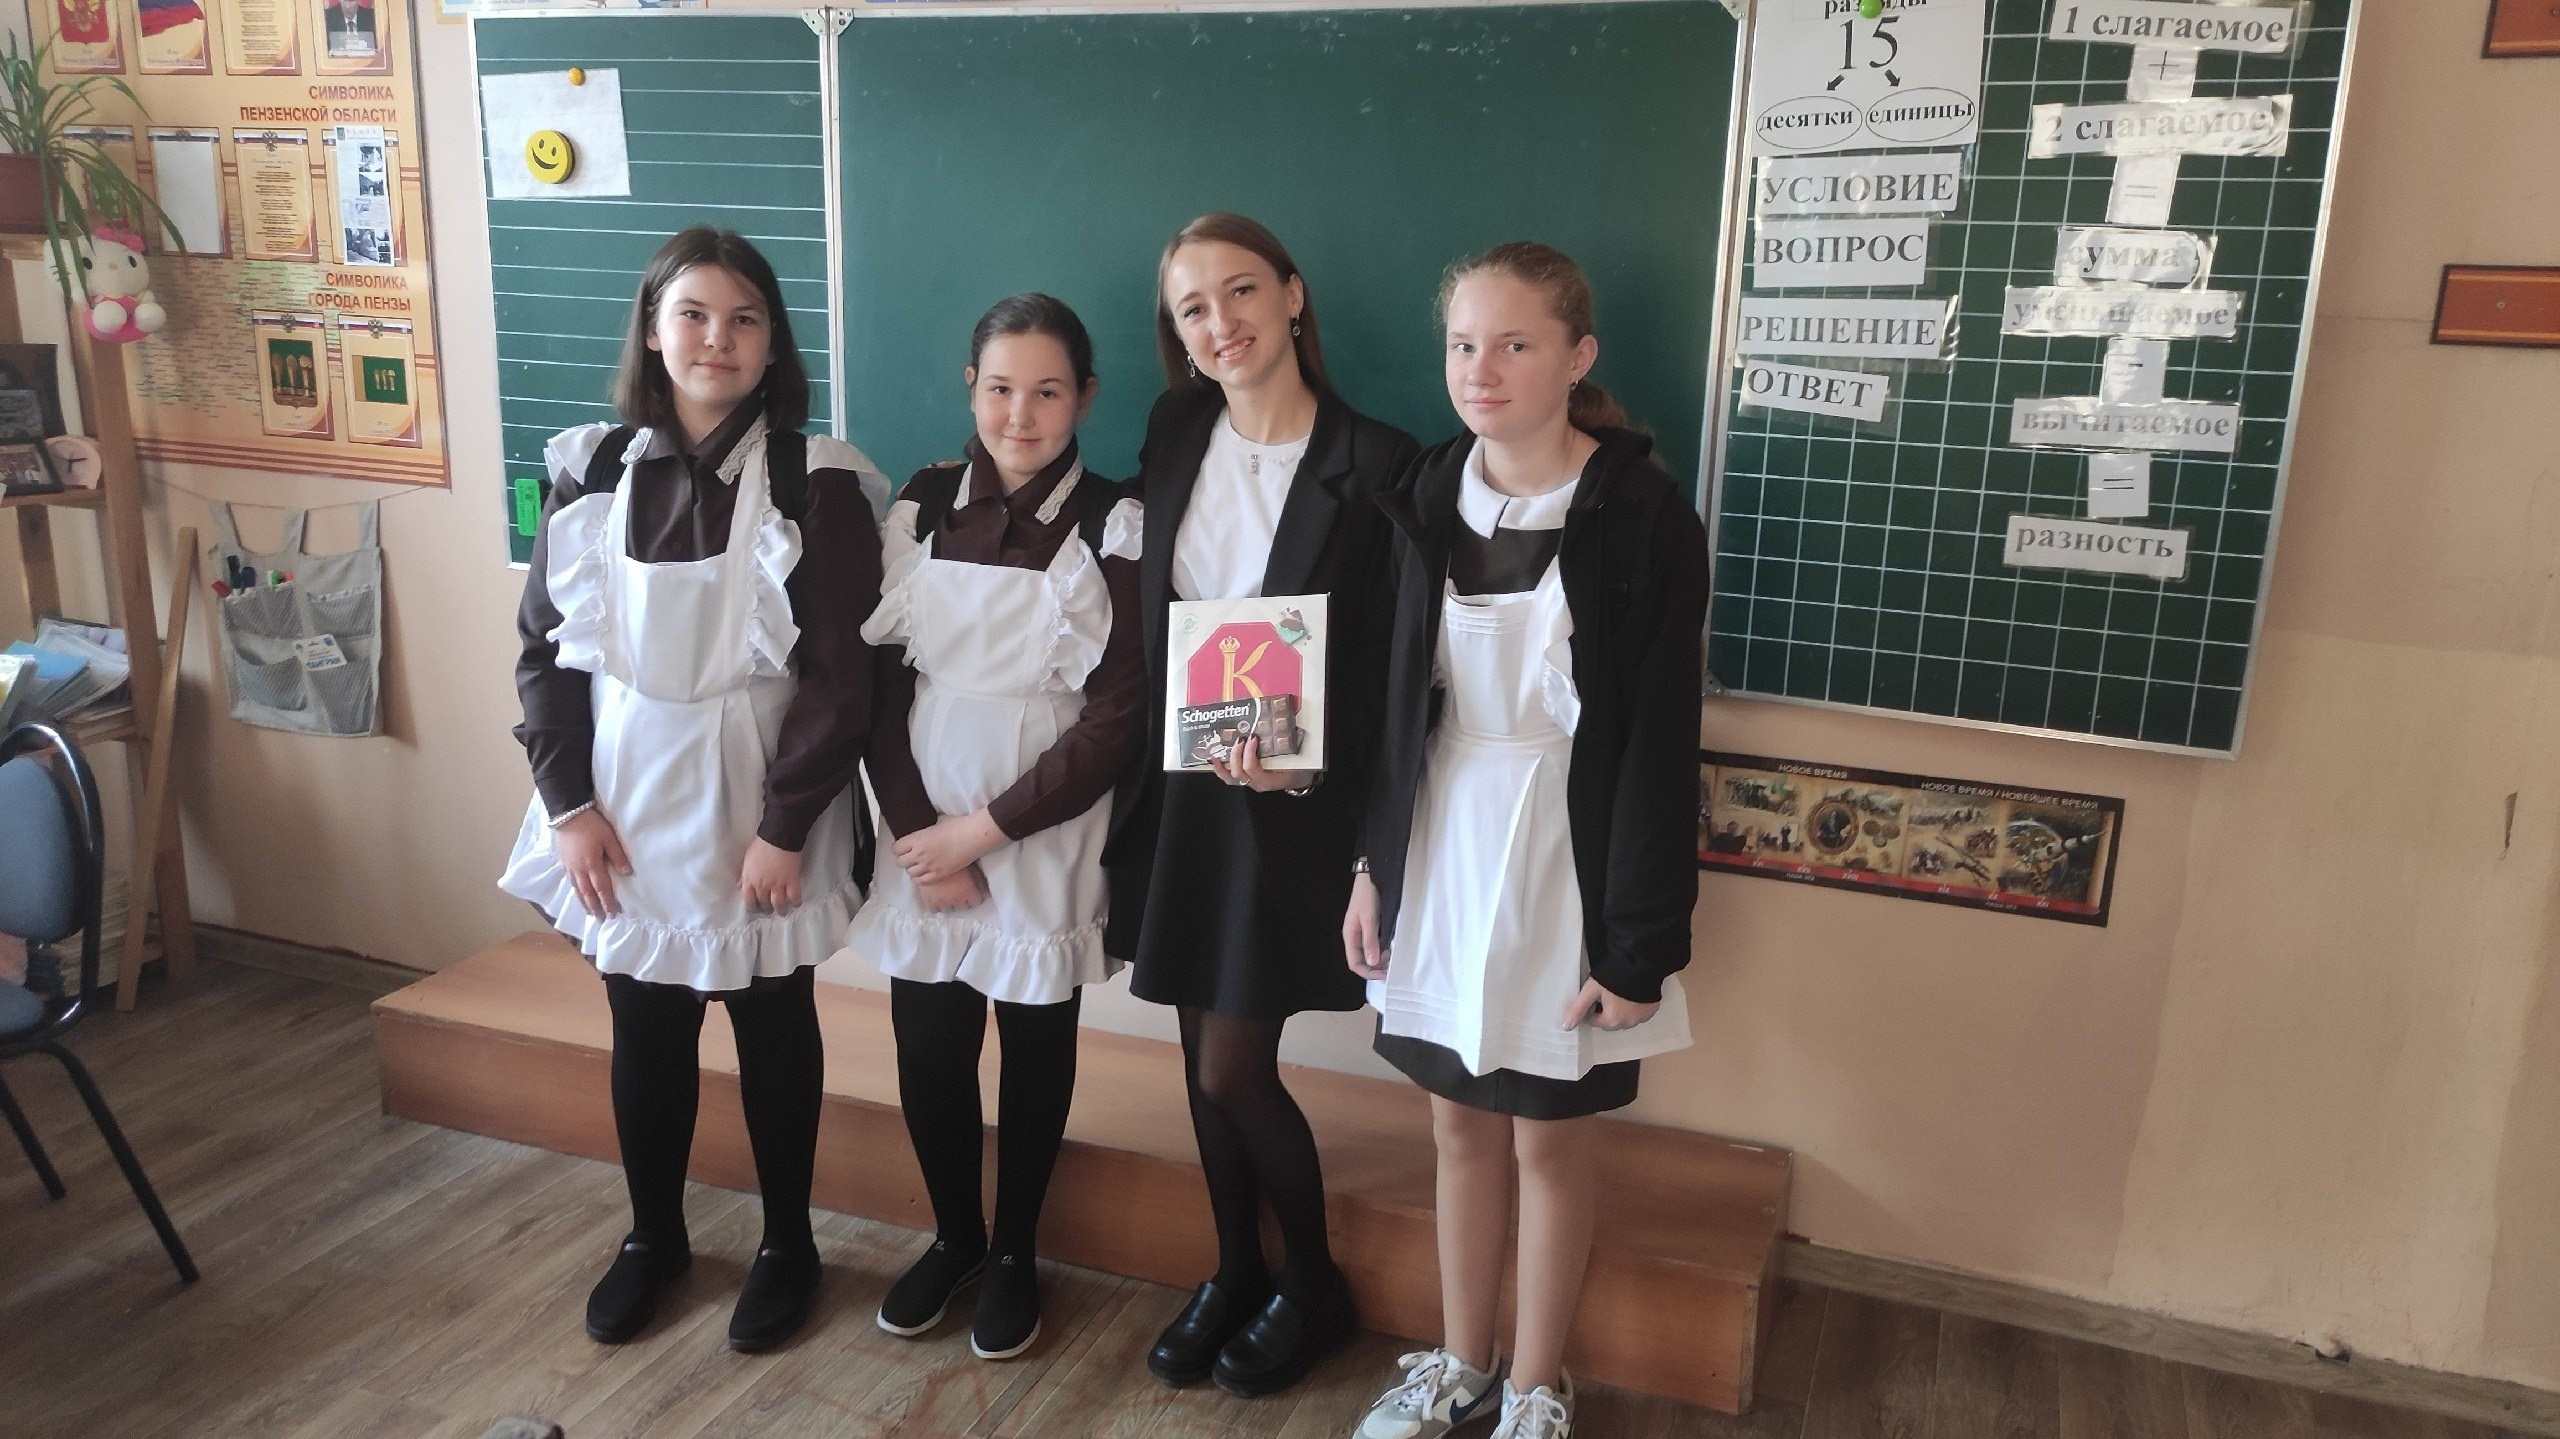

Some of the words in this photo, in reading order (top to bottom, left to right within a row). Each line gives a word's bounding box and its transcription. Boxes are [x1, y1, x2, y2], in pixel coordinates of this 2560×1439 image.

[2064, 7, 2078, 34] 1
[2092, 13, 2283, 43] слагаемое
[1840, 16, 1900, 70] 15
[309, 86, 394, 100] СИМВОЛИКА
[240, 105, 329, 122] ПЕНЗЕНСКОЙ
[333, 108, 397, 123] ОБЛАСТИ
[1758, 110, 1853, 132] десятки
[1869, 103, 1972, 124] единицы
[2045, 116, 2063, 142] 2
[2075, 109, 2271, 140] слагаемое
[1763, 173, 1953, 203] УСЛОВИЕ
[1761, 234, 1924, 264] ВОПРОС
[2067, 245, 2180, 273] сумма
[326, 273, 408, 290] СИМВОЛИКА
[308, 293, 362, 310] ГОРОДА
[364, 296, 411, 311] ПЕНЗЫ
[1743, 316, 1937, 346] РЕШЕНИЕ
[1748, 367, 1873, 408] ОТВЕТ
[2021, 412, 2230, 437] вычитаемое
[2015, 527, 2173, 558] разность
[1181, 704, 1250, 723] Schogetten
[1778, 764, 1812, 775] НОВОЕ
[1814, 769, 1848, 780] ВРЕМЯ
[1921, 782, 1956, 793] НОВОЕ
[1958, 786, 1993, 797] ВРЕМЯ
[2061, 798, 2098, 810] ВРЕМЯ
